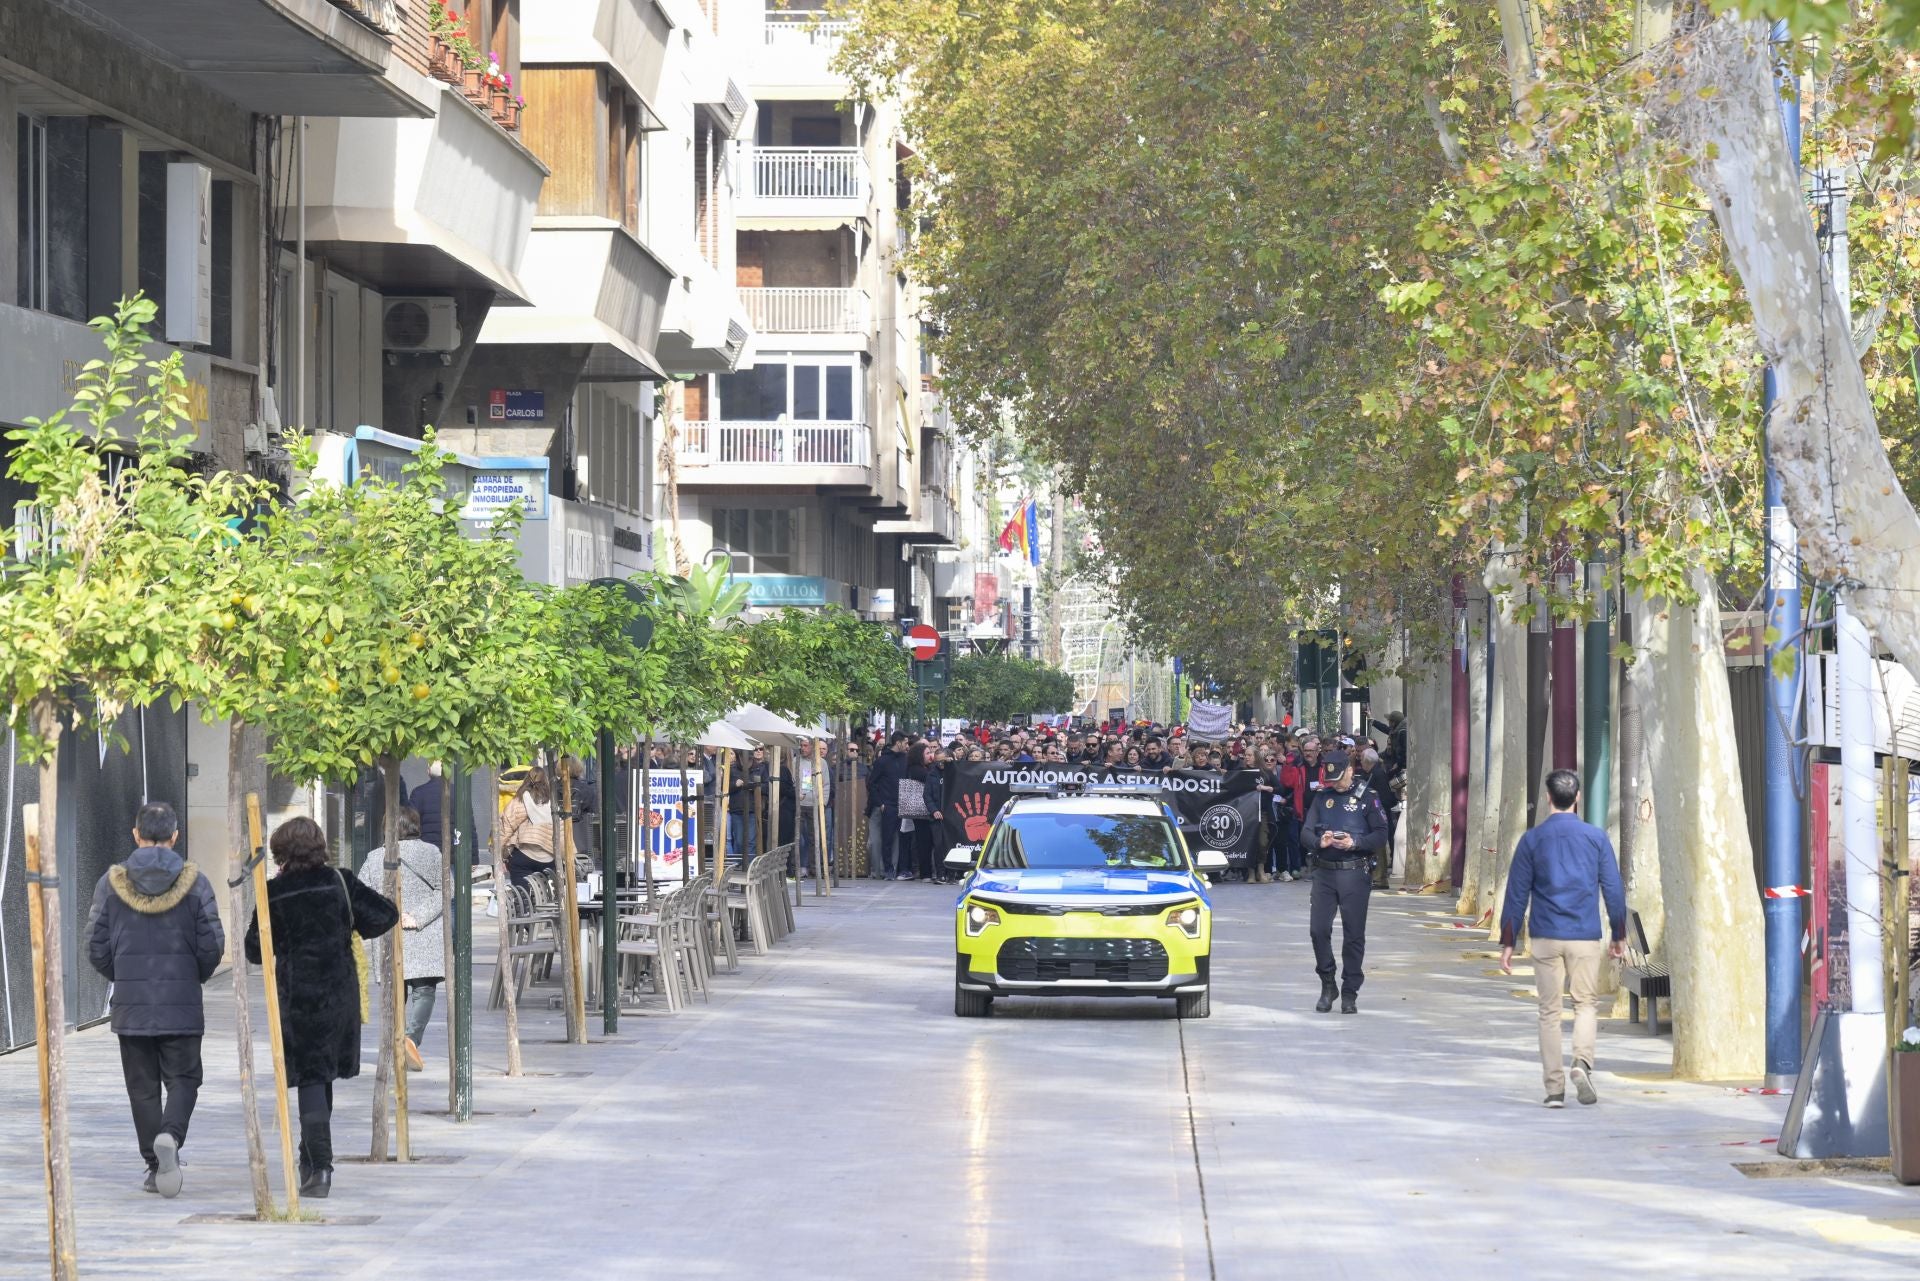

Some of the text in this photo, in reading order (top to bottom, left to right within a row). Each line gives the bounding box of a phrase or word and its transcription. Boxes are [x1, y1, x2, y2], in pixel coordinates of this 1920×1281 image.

[506, 409, 544, 417] CARLOS III
[504, 475, 514, 484] DE
[472, 486, 481, 494] LA
[771, 583, 818, 597] AYLLÓN
[982, 767, 1099, 785] AUTÓNOMOS
[1211, 815, 1230, 830] 30
[1216, 829, 1224, 839] N
